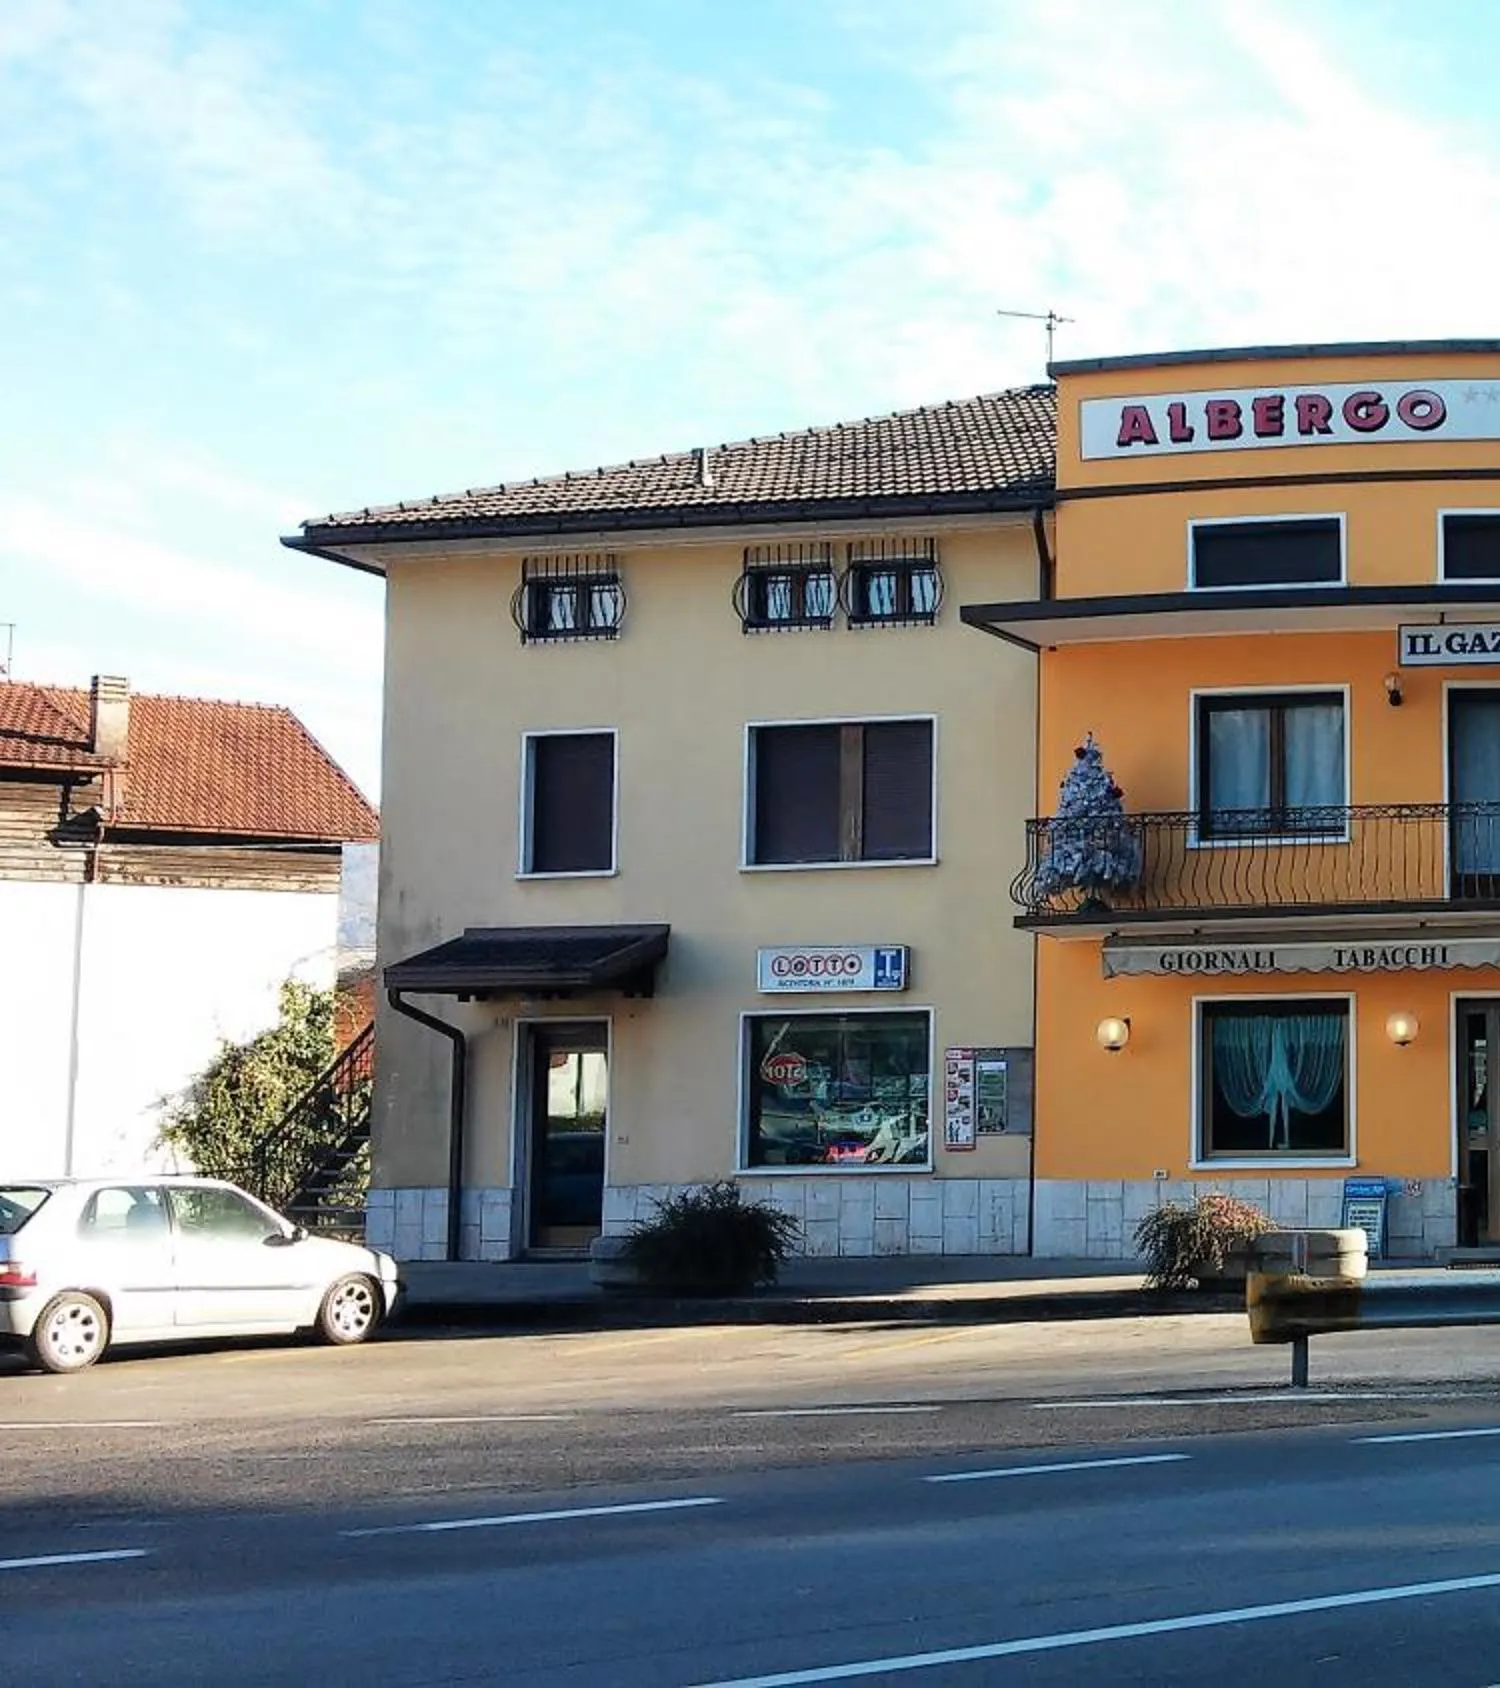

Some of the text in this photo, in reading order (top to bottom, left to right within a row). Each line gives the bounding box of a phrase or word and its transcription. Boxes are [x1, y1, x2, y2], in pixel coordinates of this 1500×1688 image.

[1116, 389, 1447, 447] ALBERGO
[1406, 634, 1441, 656] IL
[771, 953, 863, 977] LOTTO
[1159, 945, 1450, 971] GIORNALI TABACCHI
